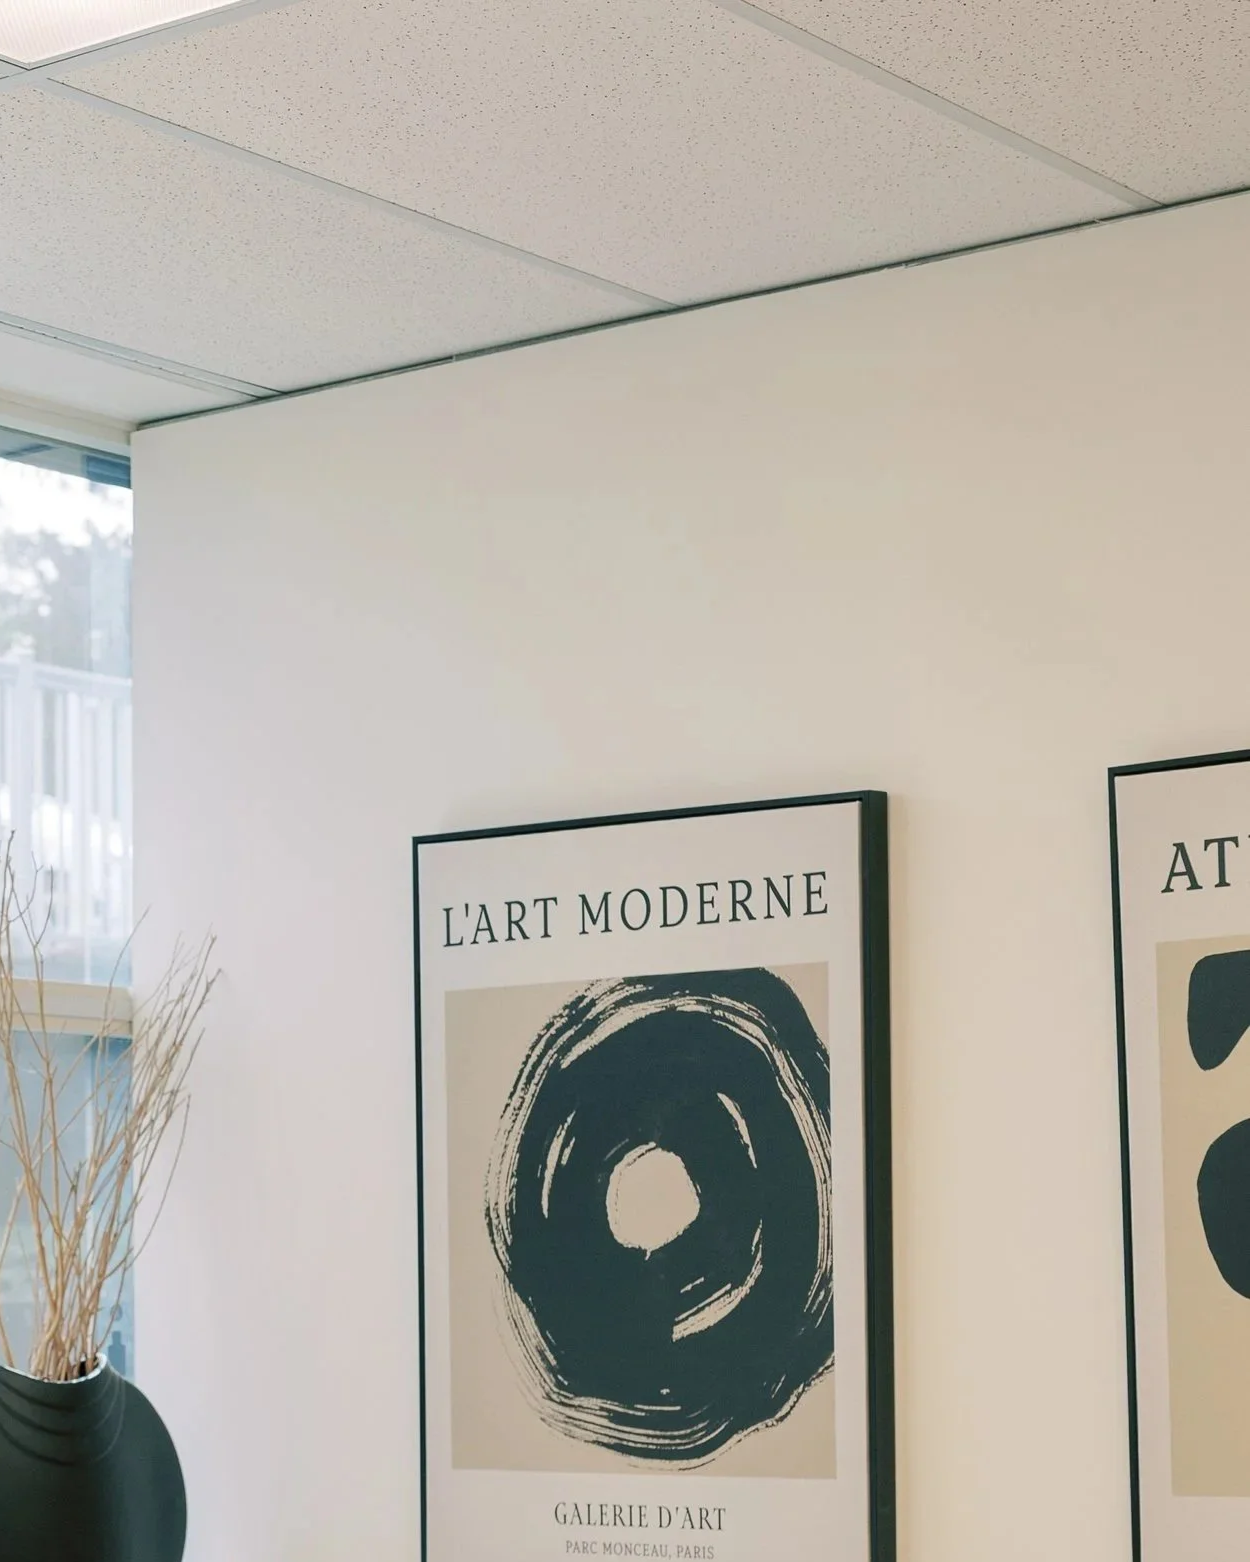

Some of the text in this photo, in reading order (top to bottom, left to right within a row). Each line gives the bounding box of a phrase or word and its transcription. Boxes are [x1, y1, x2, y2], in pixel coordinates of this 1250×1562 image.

[1161, 835, 1250, 894] AT
[442, 871, 829, 947] L'ART MODERNE
[554, 1501, 727, 1531] GALERIE D'ART
[565, 1540, 715, 1560] PARC MONCEAU, PARIS
